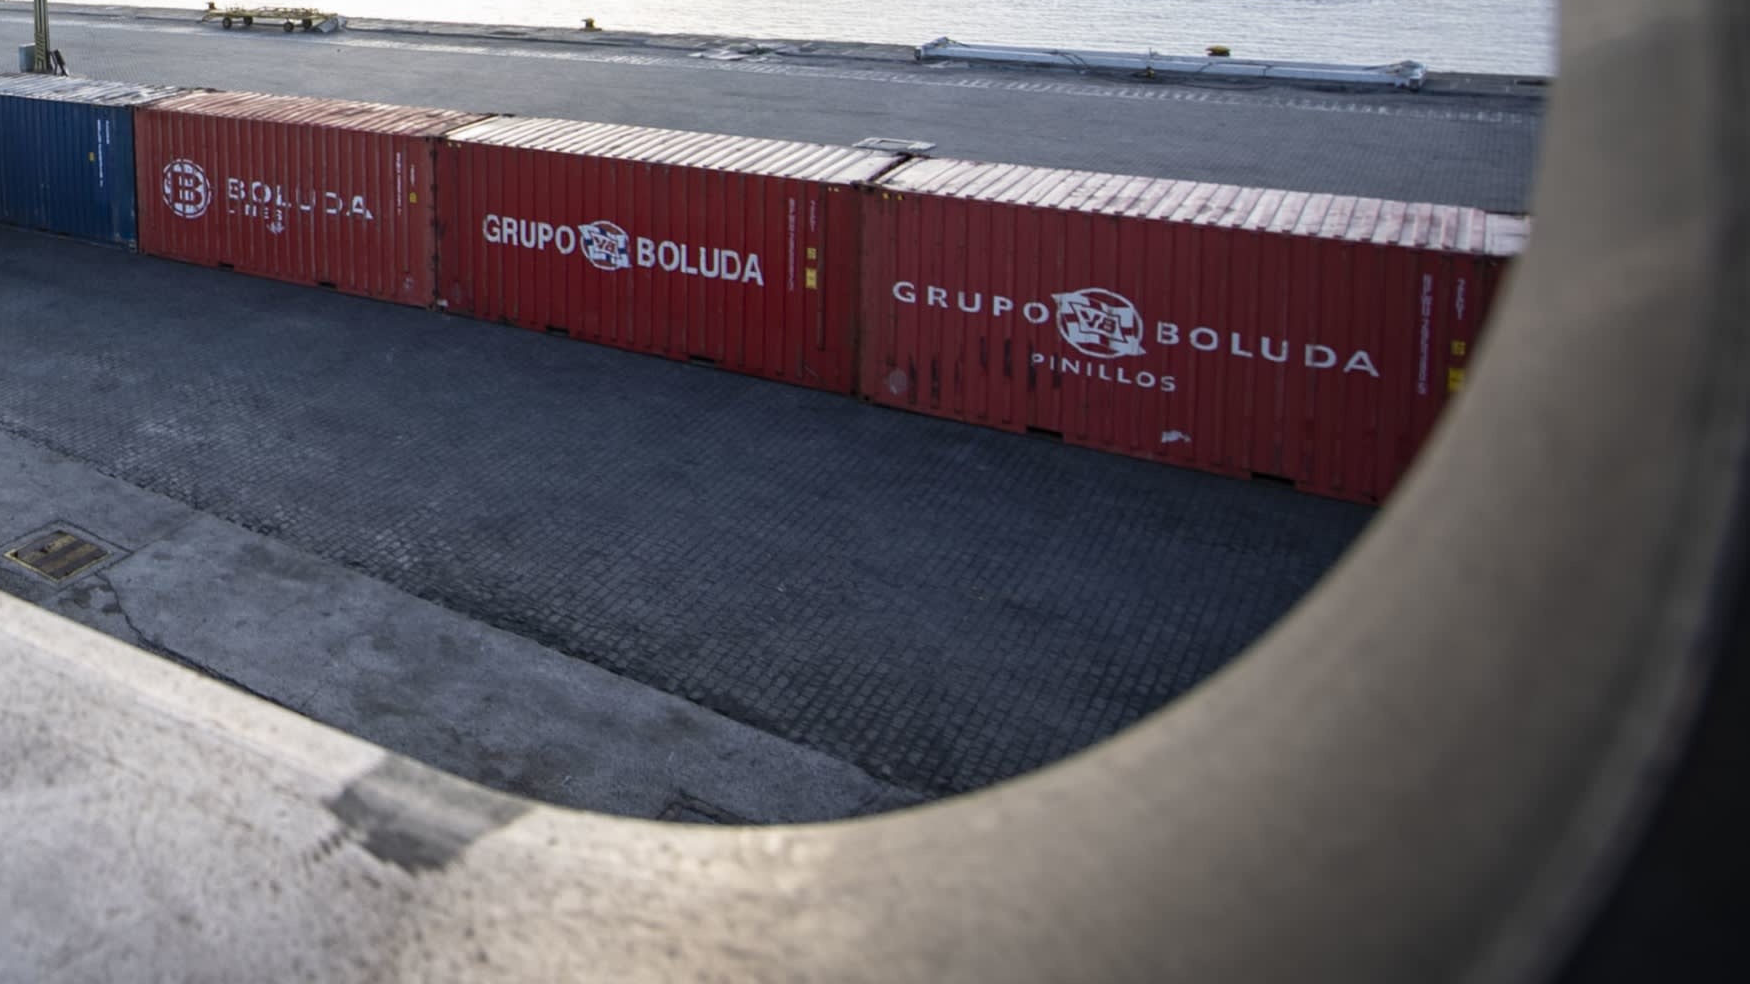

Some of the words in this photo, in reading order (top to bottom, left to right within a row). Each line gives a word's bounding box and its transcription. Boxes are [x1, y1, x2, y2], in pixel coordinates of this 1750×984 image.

[227, 177, 373, 220] BOLUDA
[482, 214, 576, 255] GRUPO
[636, 236, 764, 286] BOLUDA
[892, 281, 1050, 324] GRUPO
[1156, 321, 1379, 377] BOLUDA
[1030, 353, 1176, 392] PINILLOS
